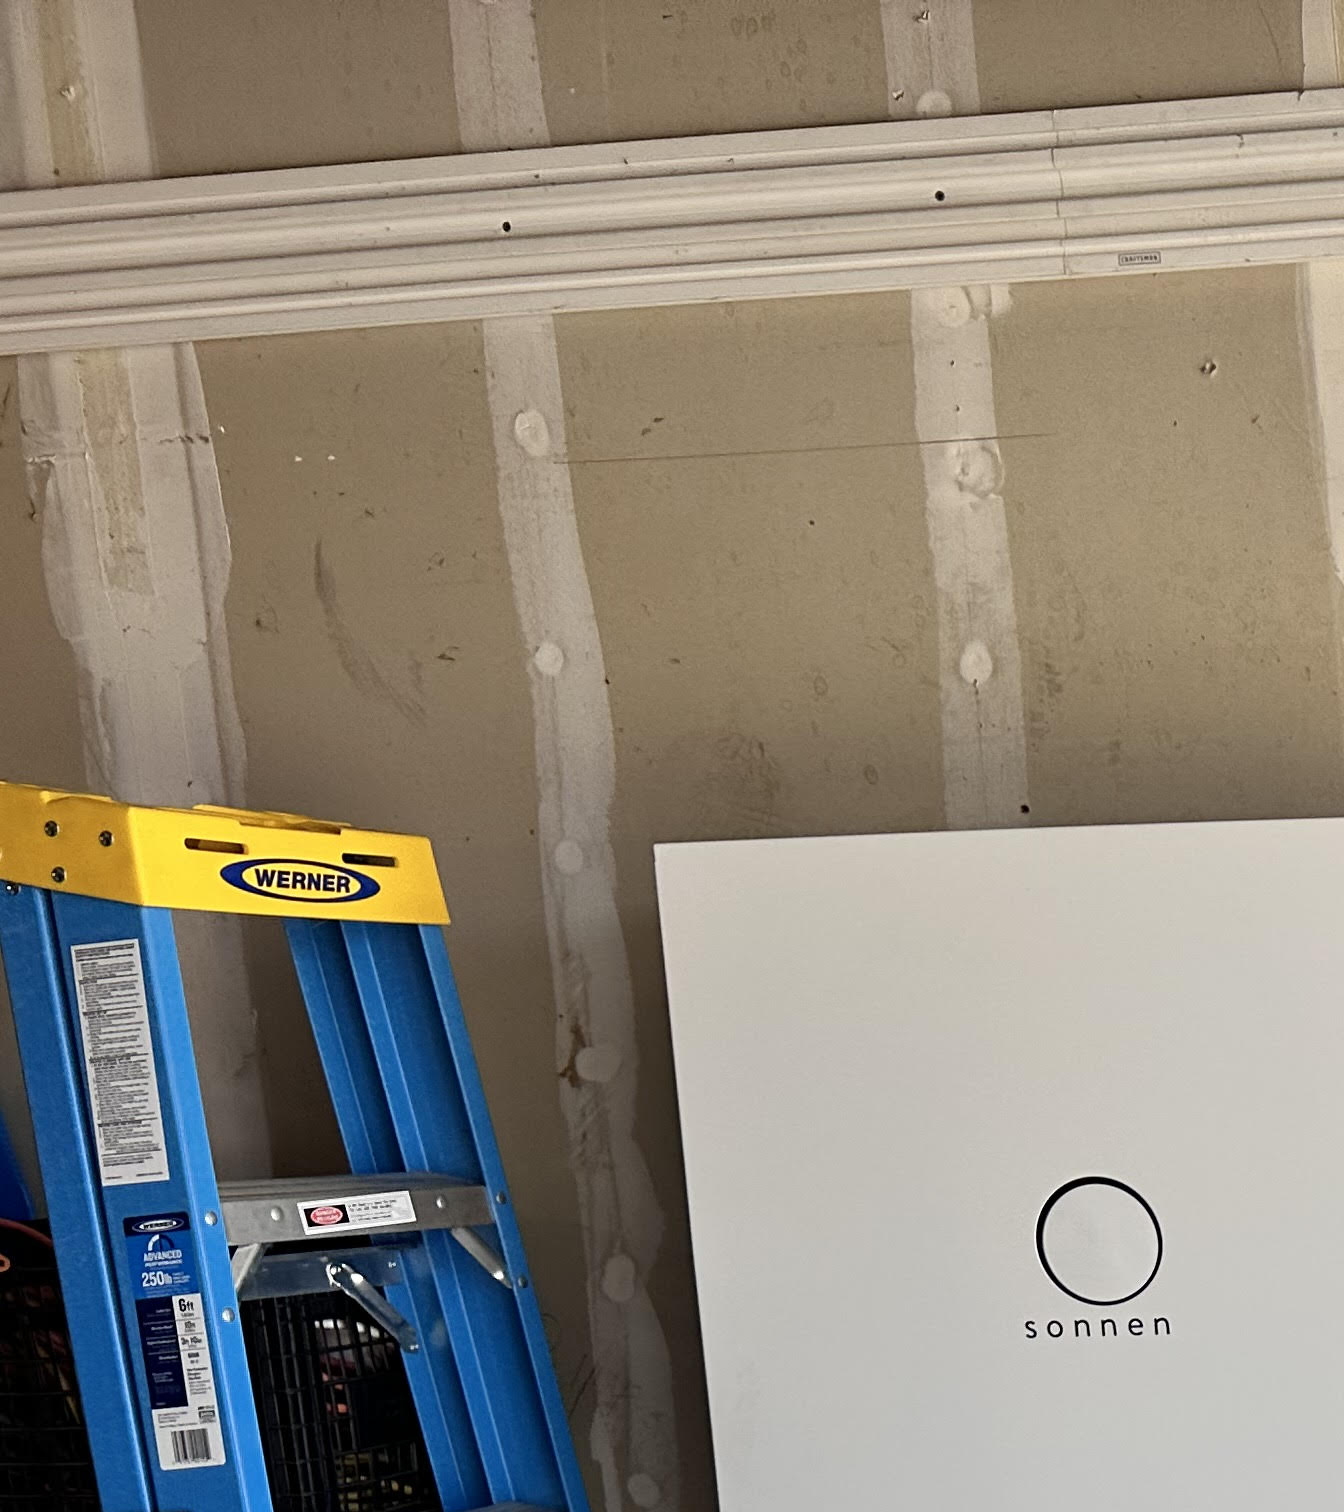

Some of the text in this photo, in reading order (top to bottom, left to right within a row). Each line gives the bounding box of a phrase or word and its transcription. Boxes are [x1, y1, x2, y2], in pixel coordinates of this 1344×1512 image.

[254, 868, 351, 893] WERNER
[143, 1249, 182, 1262] ADVANCED
[1024, 1317, 1171, 1339] sonnen
